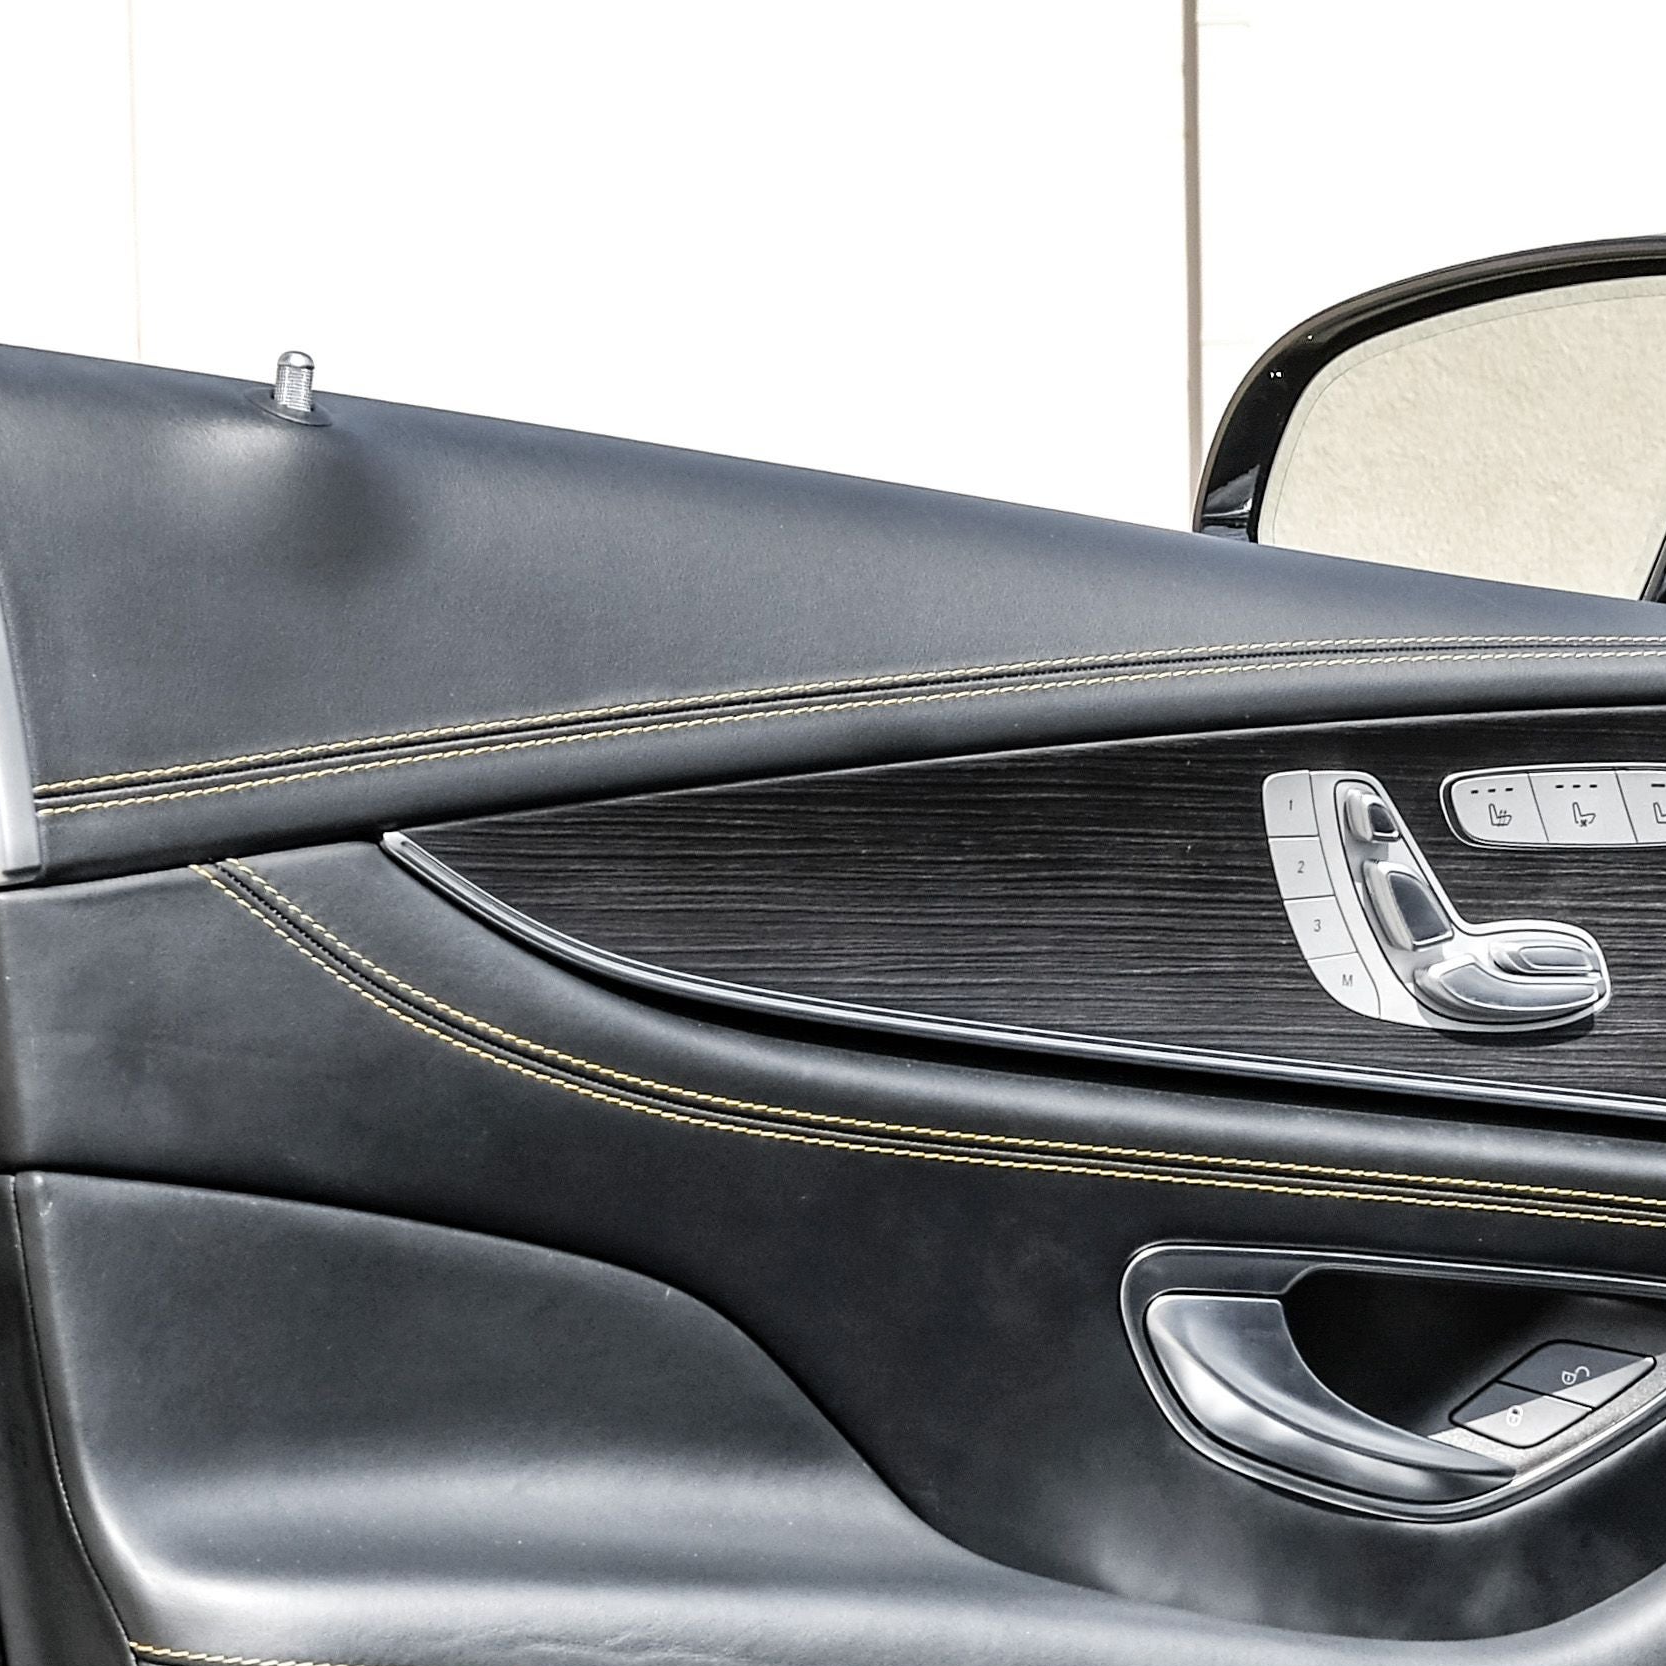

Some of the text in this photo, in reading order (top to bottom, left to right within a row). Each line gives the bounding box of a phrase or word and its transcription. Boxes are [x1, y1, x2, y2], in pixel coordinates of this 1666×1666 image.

[1297, 860, 1305, 874] 2
[1314, 919, 1322, 932] 3
[1342, 974, 1354, 986] M
